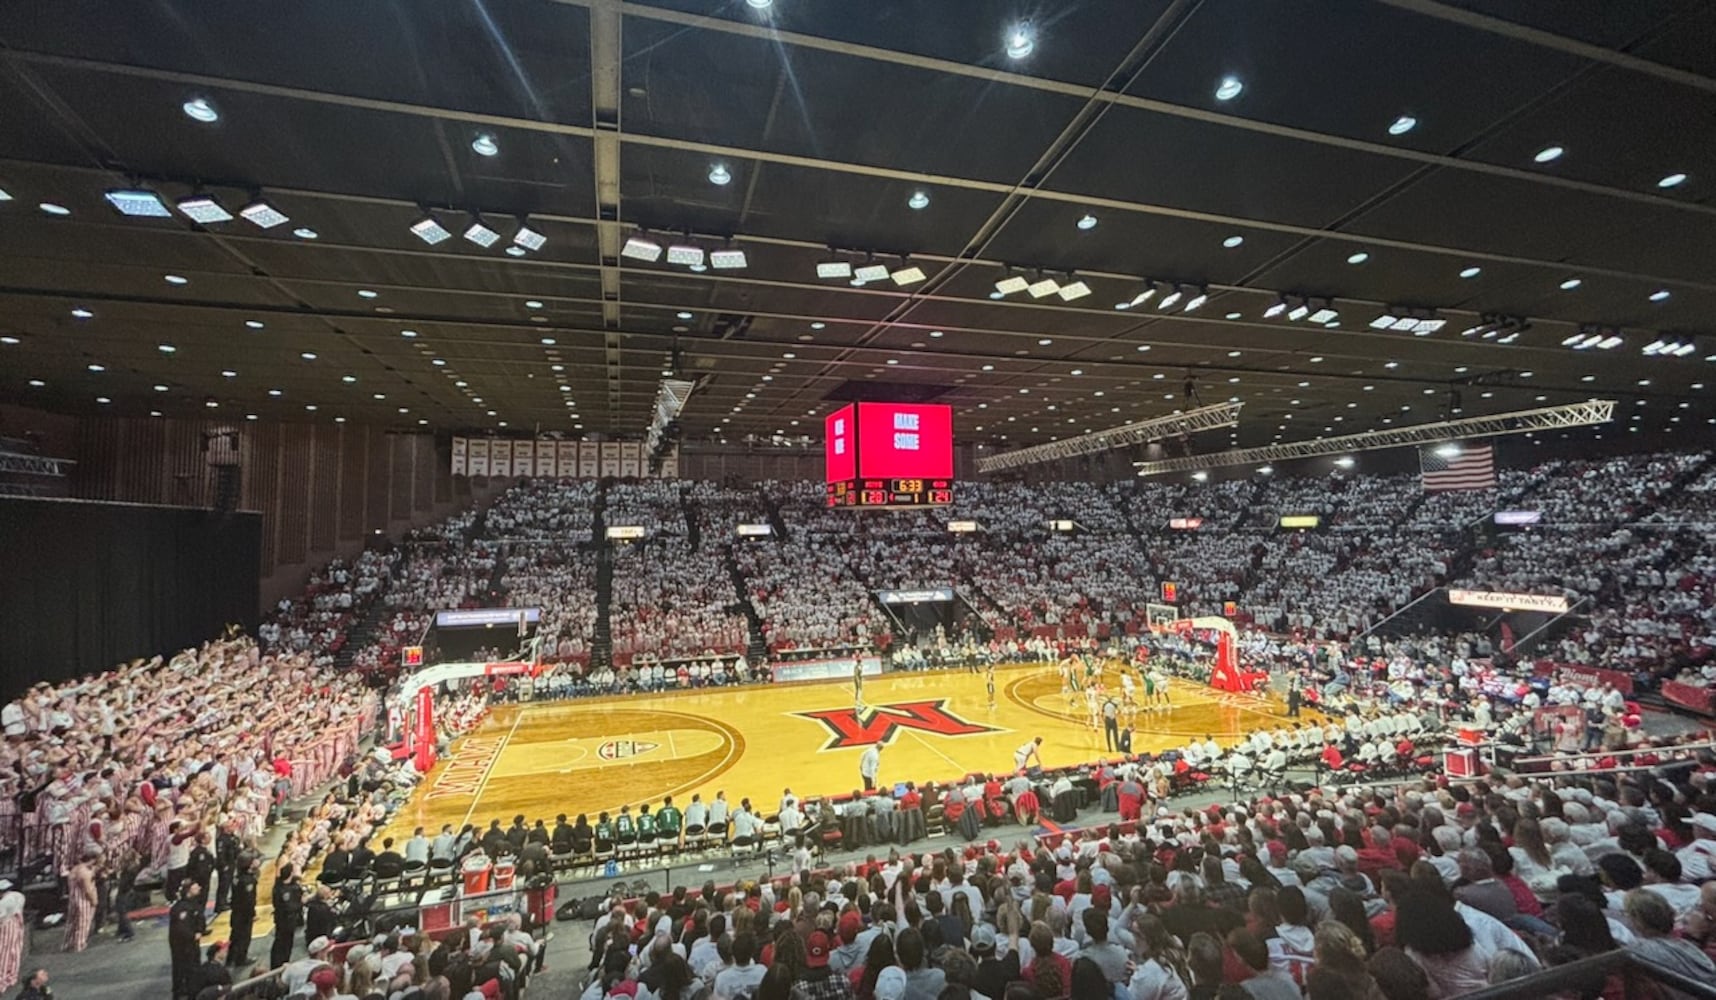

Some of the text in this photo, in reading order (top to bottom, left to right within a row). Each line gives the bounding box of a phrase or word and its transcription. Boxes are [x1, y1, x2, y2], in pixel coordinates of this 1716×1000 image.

[894, 413, 919, 430] MAKE
[894, 433, 919, 450] SOME
[899, 480, 922, 492] 6:33
[1477, 594, 1502, 602] KEEP
[1505, 595, 1516, 603] IT
